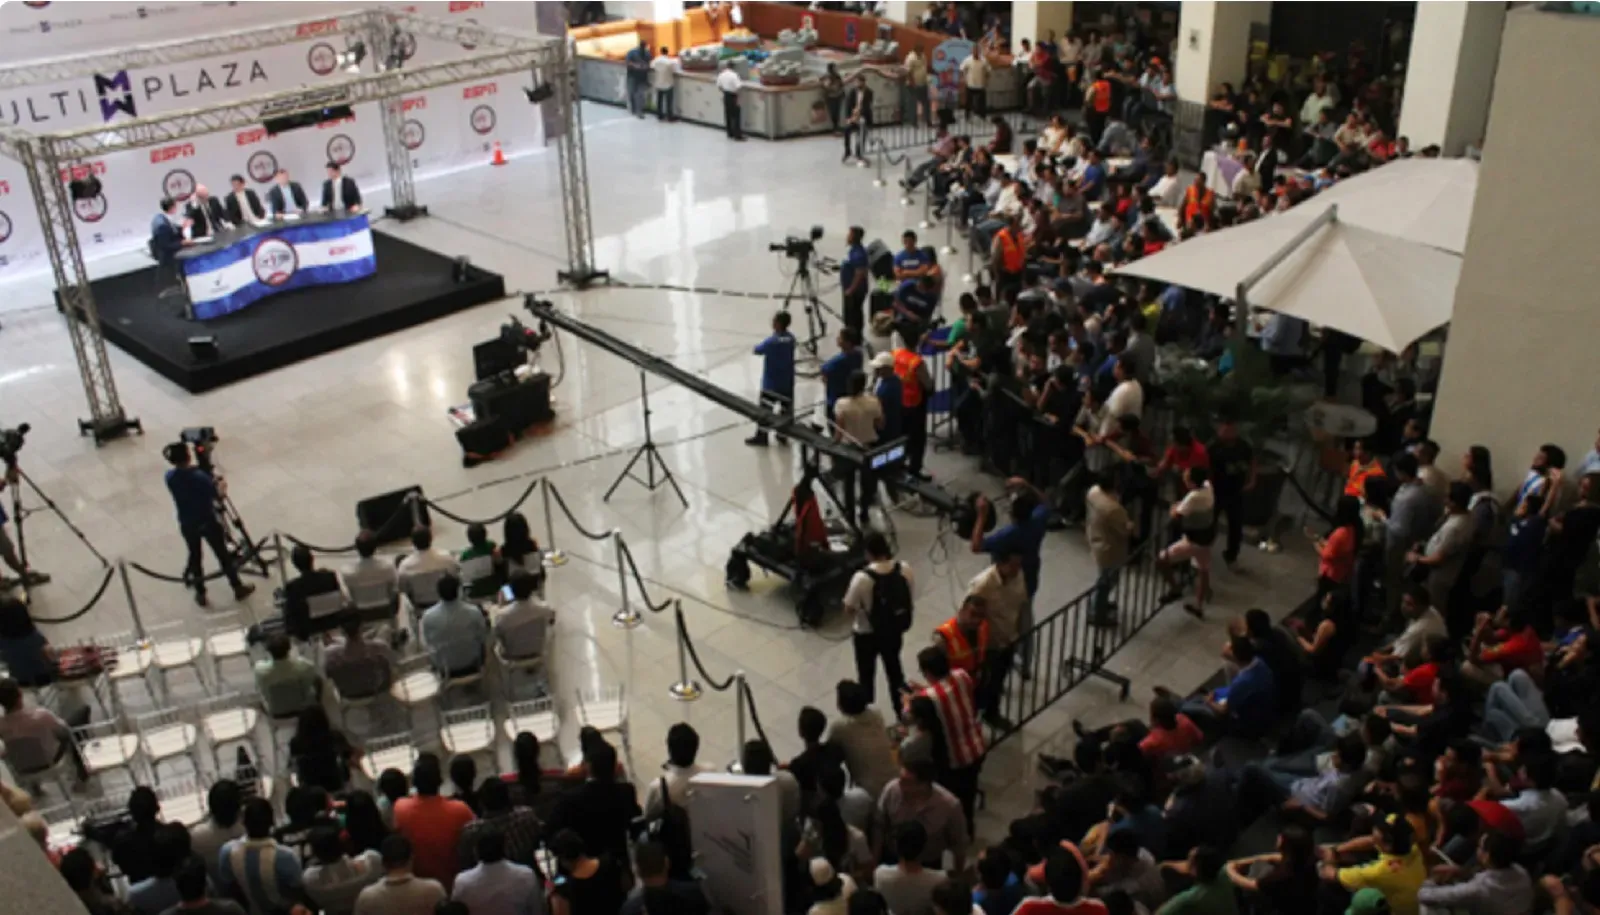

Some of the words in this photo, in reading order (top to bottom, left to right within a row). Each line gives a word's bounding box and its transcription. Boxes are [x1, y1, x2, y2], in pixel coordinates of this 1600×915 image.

[143, 60, 268, 101] PLAZA
[463, 82, 497, 99] ESPN
[236, 127, 278, 146] ESP
[150, 142, 195, 164] ESPN
